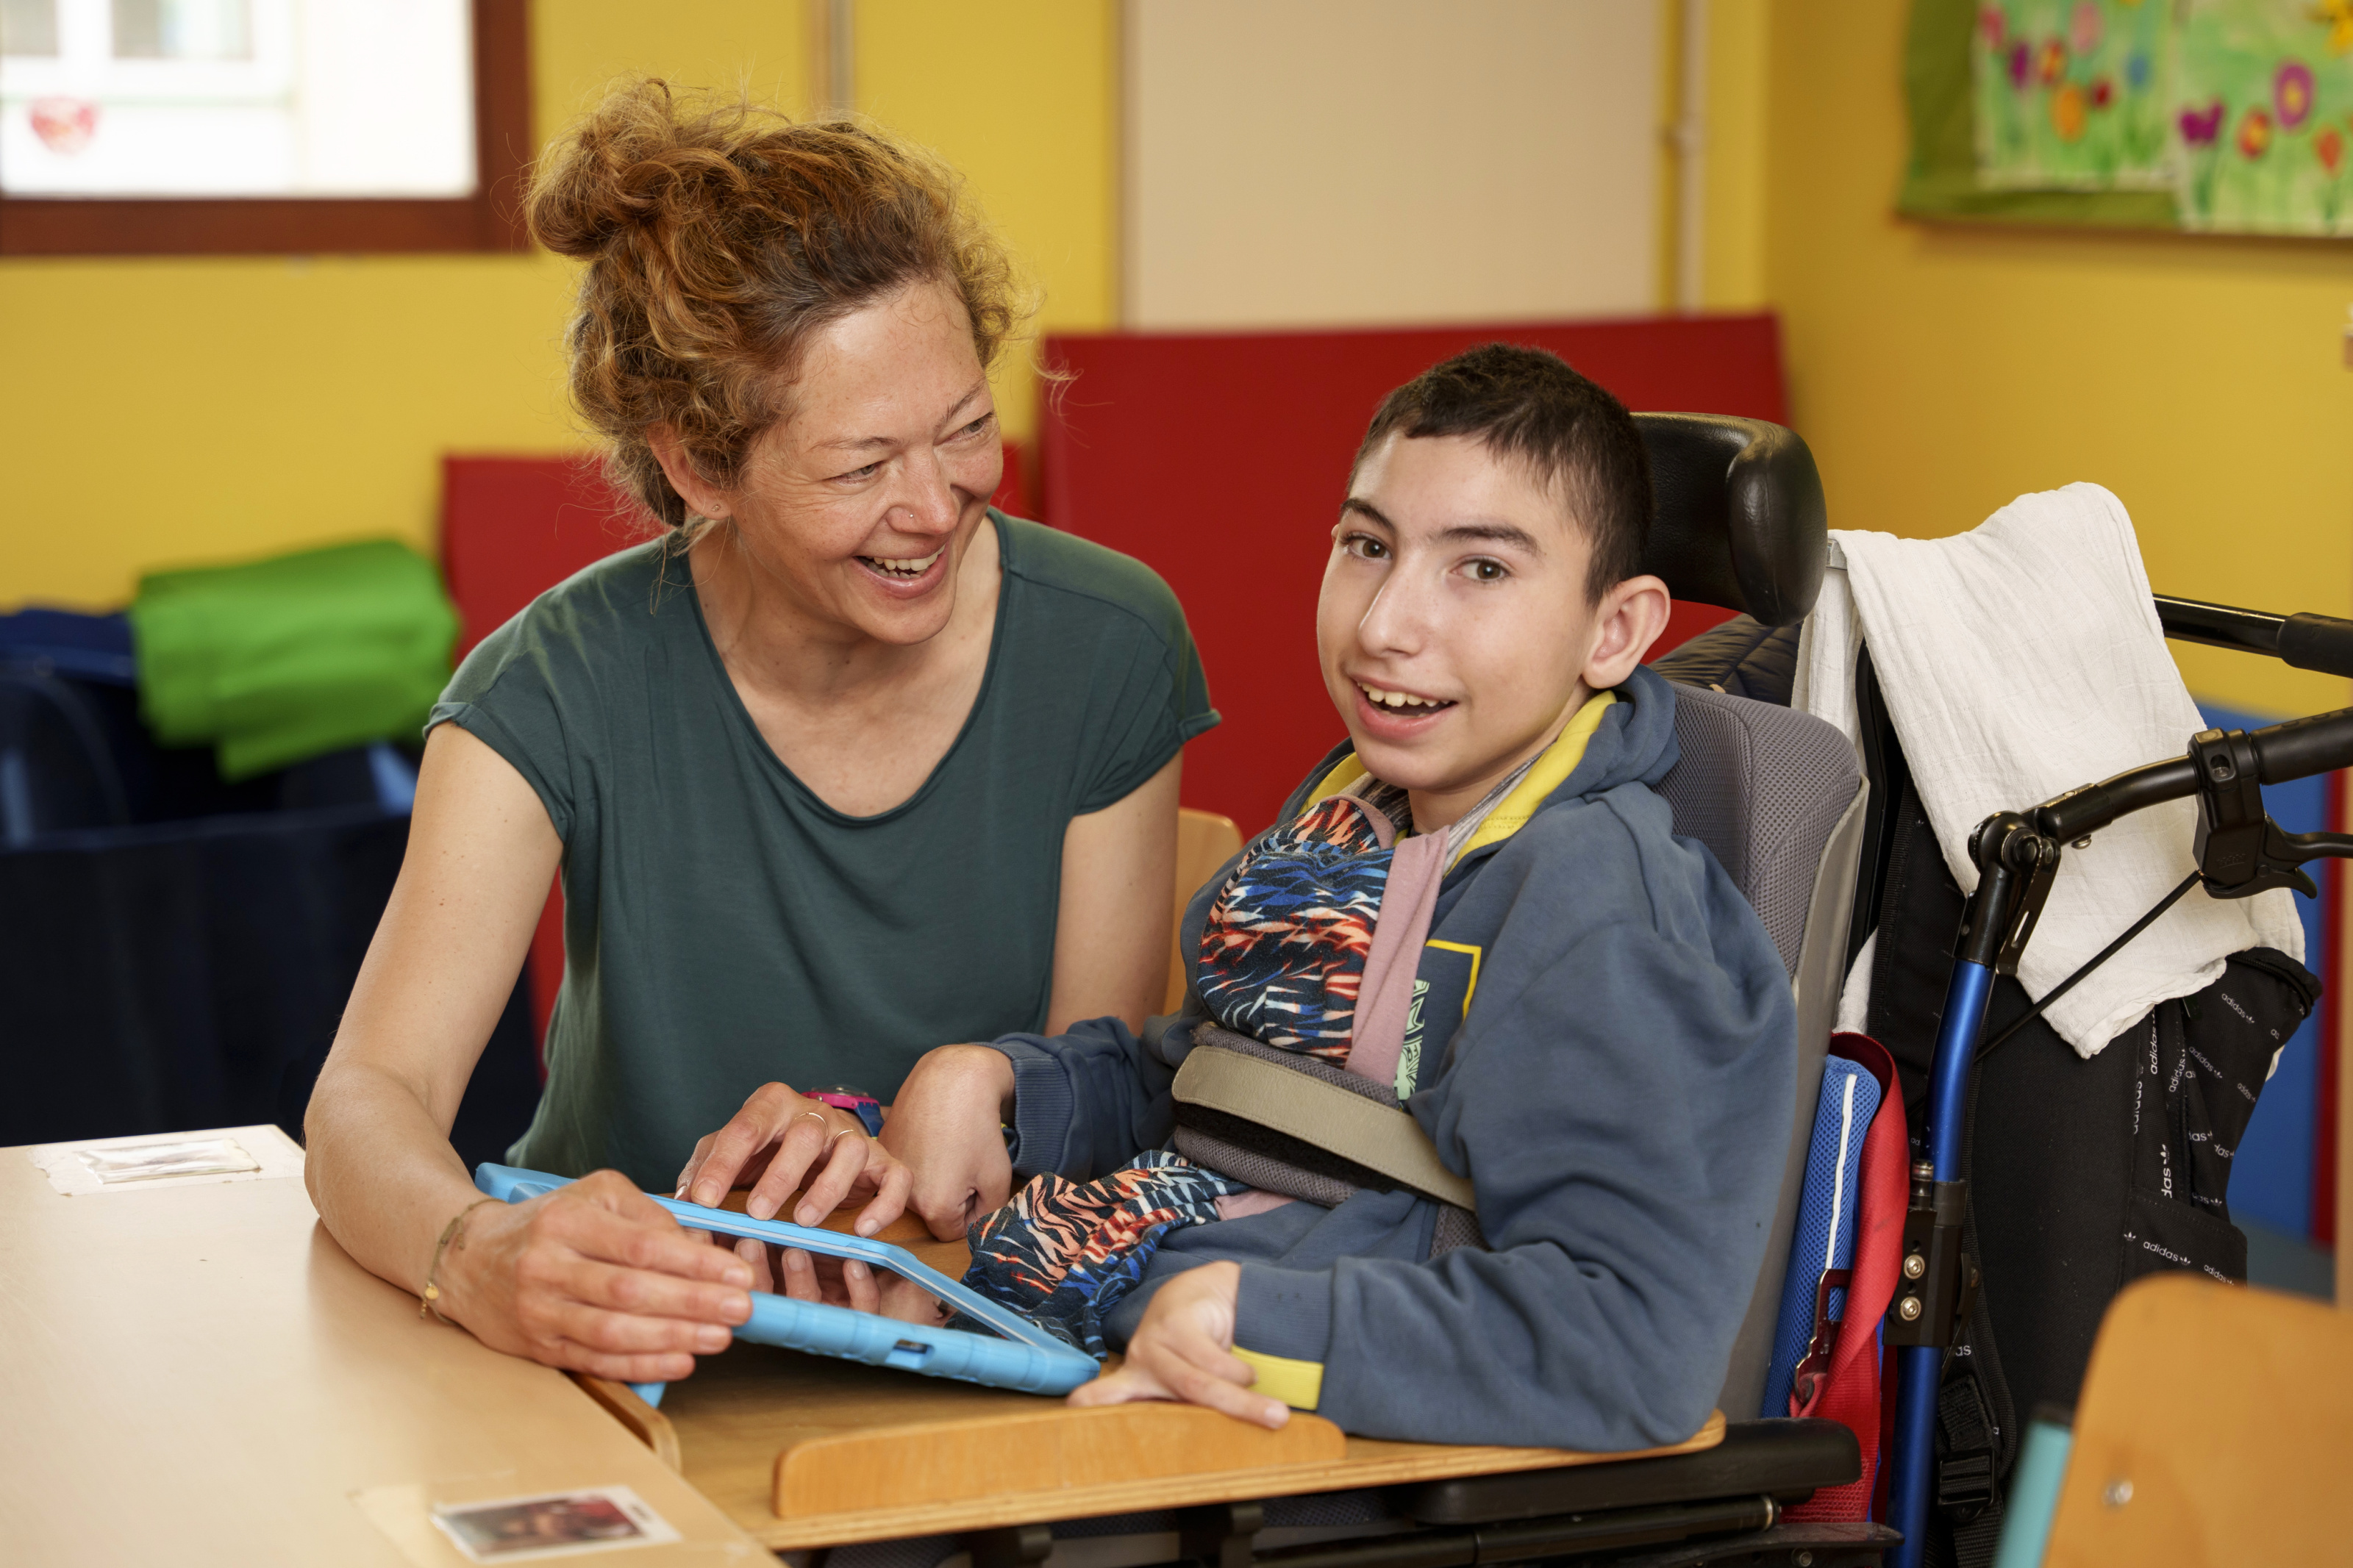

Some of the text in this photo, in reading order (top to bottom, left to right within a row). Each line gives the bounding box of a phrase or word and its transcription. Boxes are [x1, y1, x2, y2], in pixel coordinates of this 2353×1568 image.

[2221, 993, 2246, 1018] adidas
[2149, 1026, 2158, 1075] adidas
[2188, 1046, 2214, 1072] adidas
[2143, 1241, 2179, 1262] adidas
[2204, 1264, 2227, 1283] adidas
